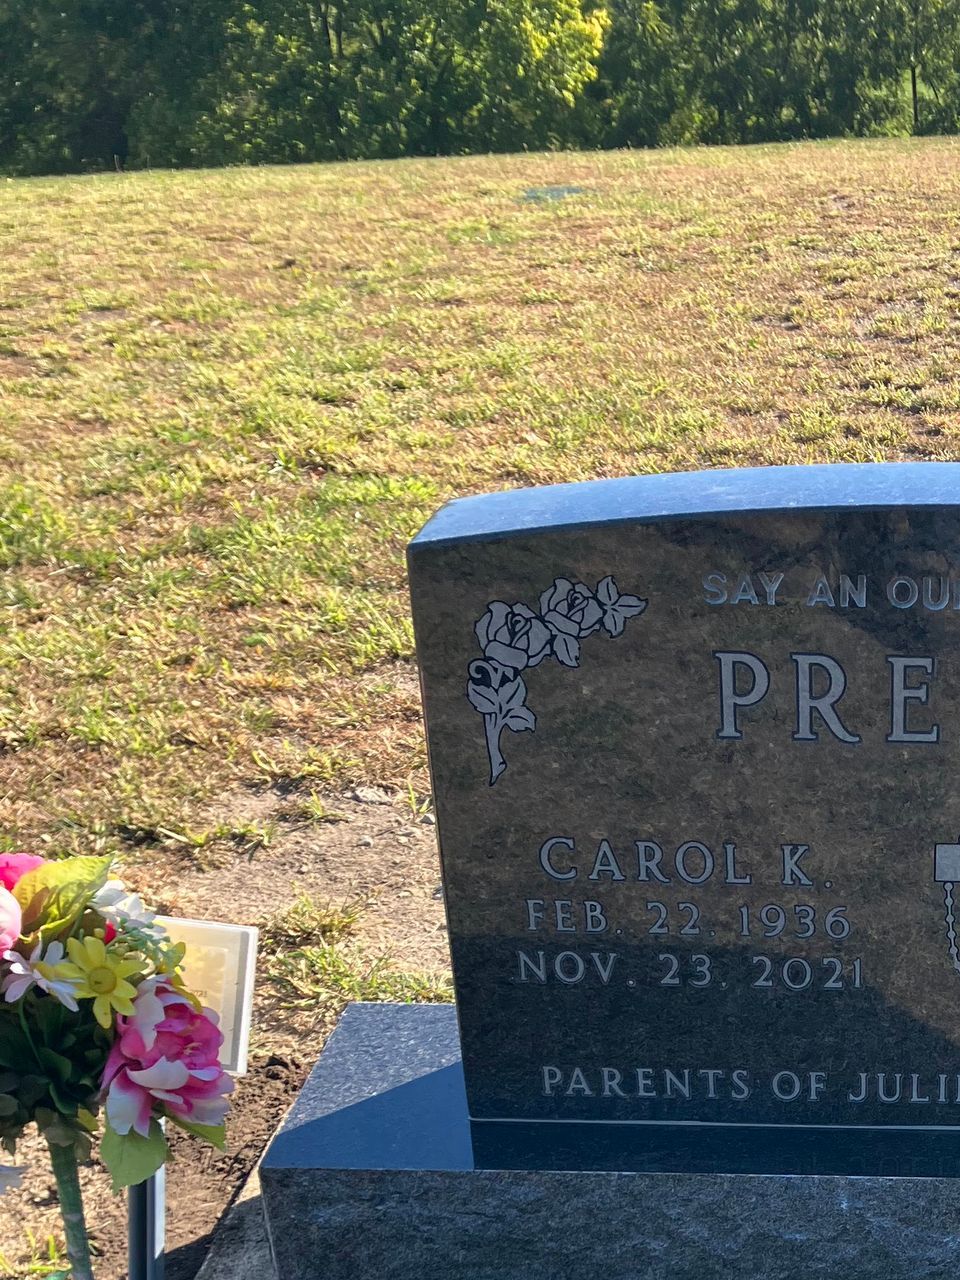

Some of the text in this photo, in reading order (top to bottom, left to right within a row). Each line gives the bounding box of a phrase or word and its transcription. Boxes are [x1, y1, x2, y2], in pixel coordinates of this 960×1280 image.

[702, 573, 785, 607] SAY
[807, 575, 868, 609] AN
[539, 836, 834, 888] CAROL K.
[525, 899, 624, 935] FEB.
[739, 905, 852, 940] 1936
[518, 950, 636, 988] NOV.
[751, 956, 864, 990] 2021
[542, 1065, 750, 1100] PARENTS
[772, 1071, 828, 1101] OF
